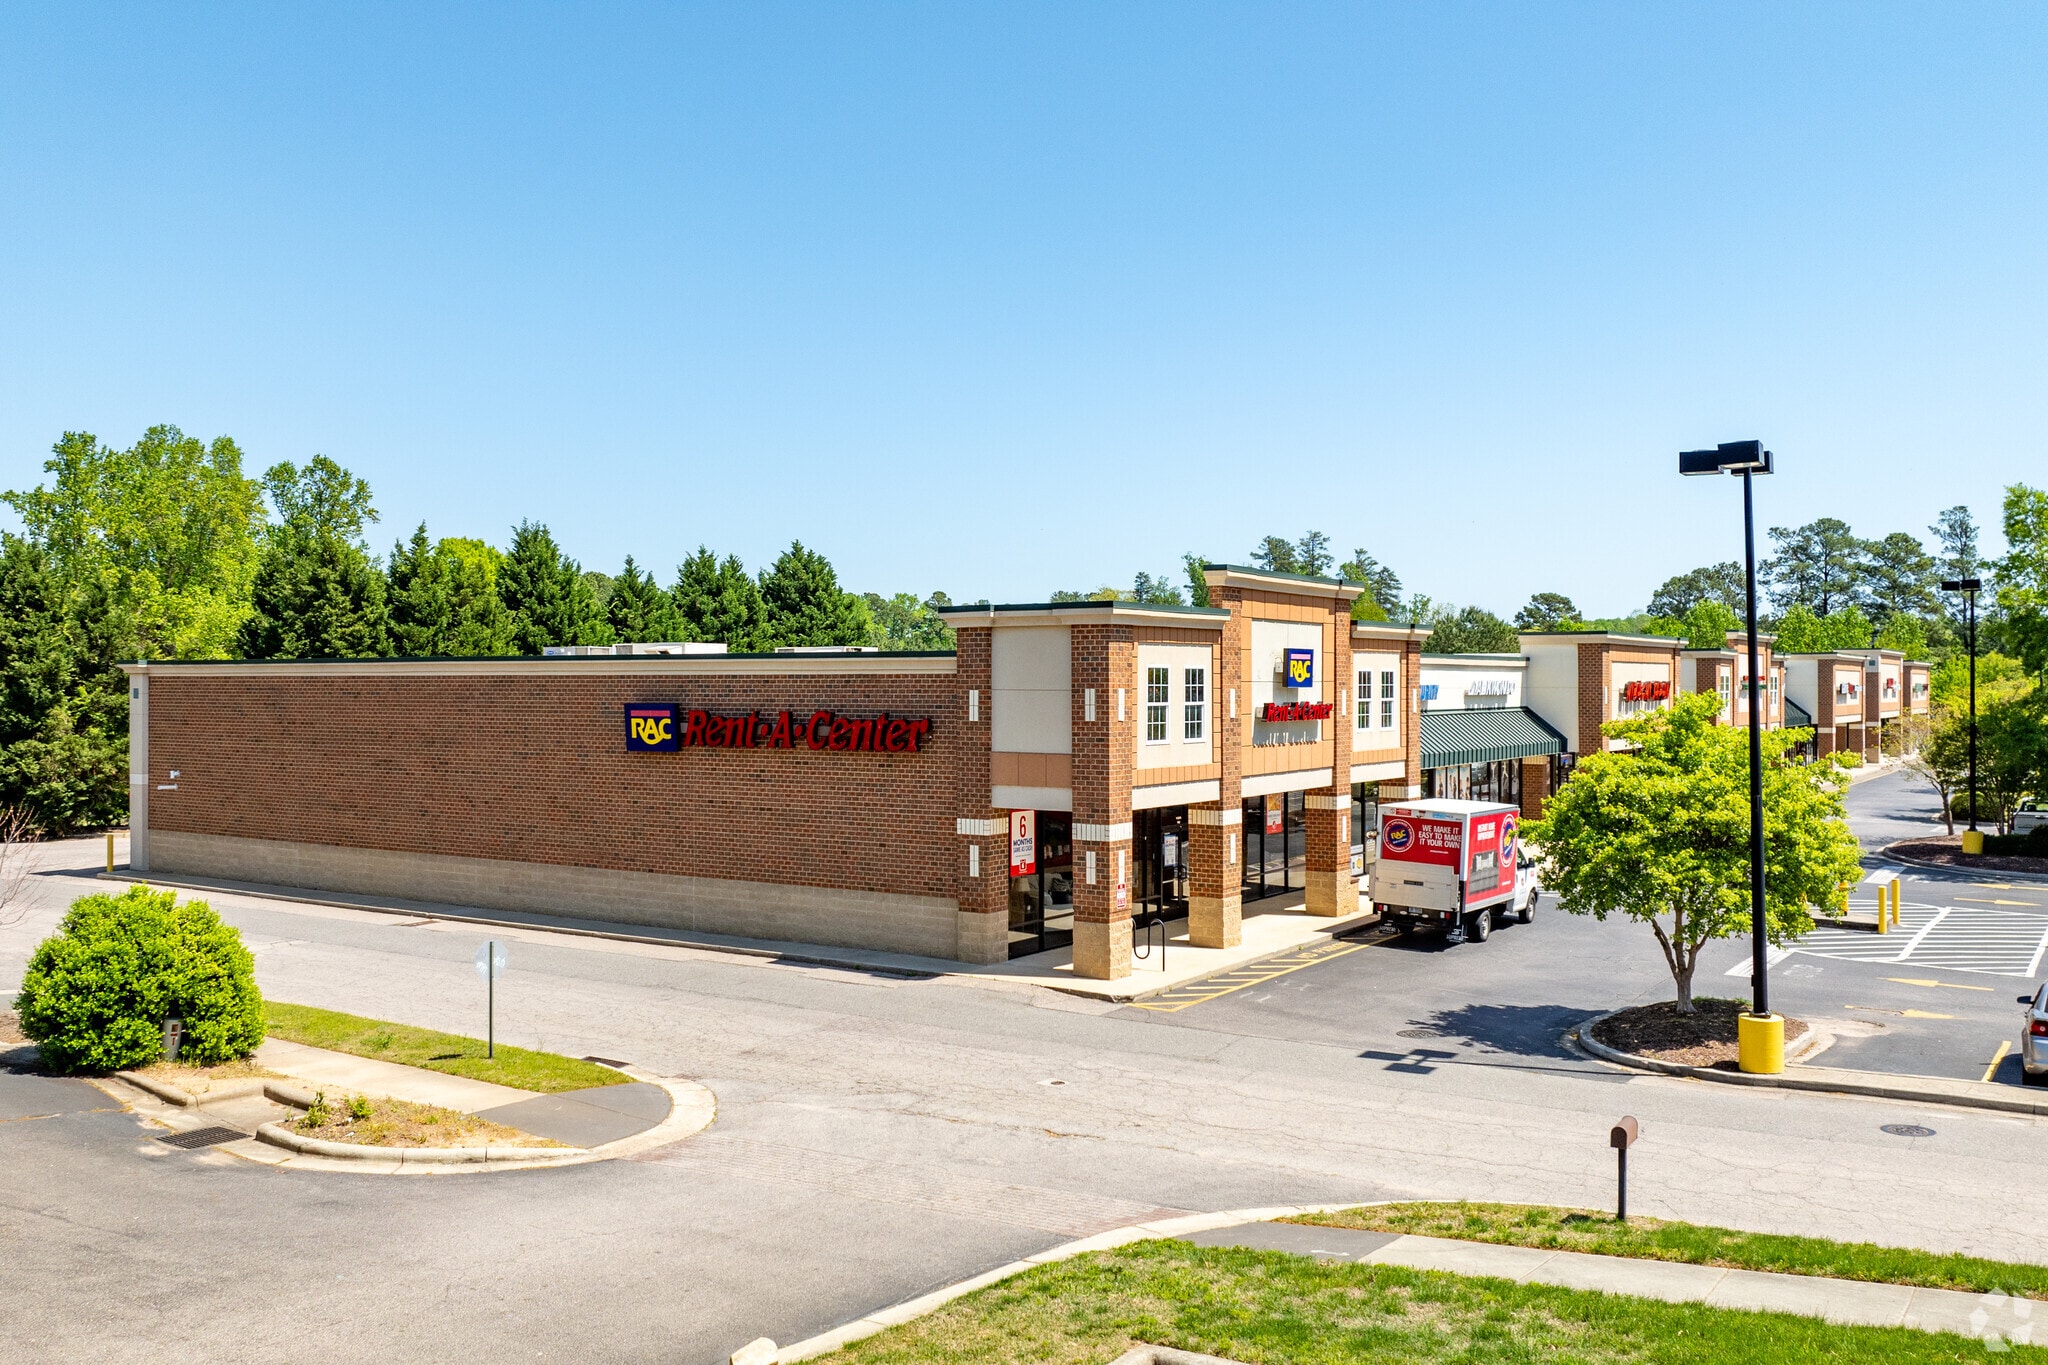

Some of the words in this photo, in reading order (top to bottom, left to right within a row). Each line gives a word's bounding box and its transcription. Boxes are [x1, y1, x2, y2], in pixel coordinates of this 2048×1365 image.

[1289, 660, 1311, 683] RAC
[630, 717, 672, 745] RAC
[1020, 815, 1026, 838] 6
[1433, 825, 1452, 834] MAKE
[1453, 827, 1460, 835] IT
[1390, 829, 1406, 839] RAC
[1418, 831, 1433, 839] EASY
[1435, 832, 1443, 840] TO
[1444, 834, 1462, 842] MAKE
[1013, 838, 1032, 846] MONTHS
[1419, 838, 1425, 846] IT
[1427, 839, 1443, 848] YOUR
[1444, 841, 1460, 849] OWN
